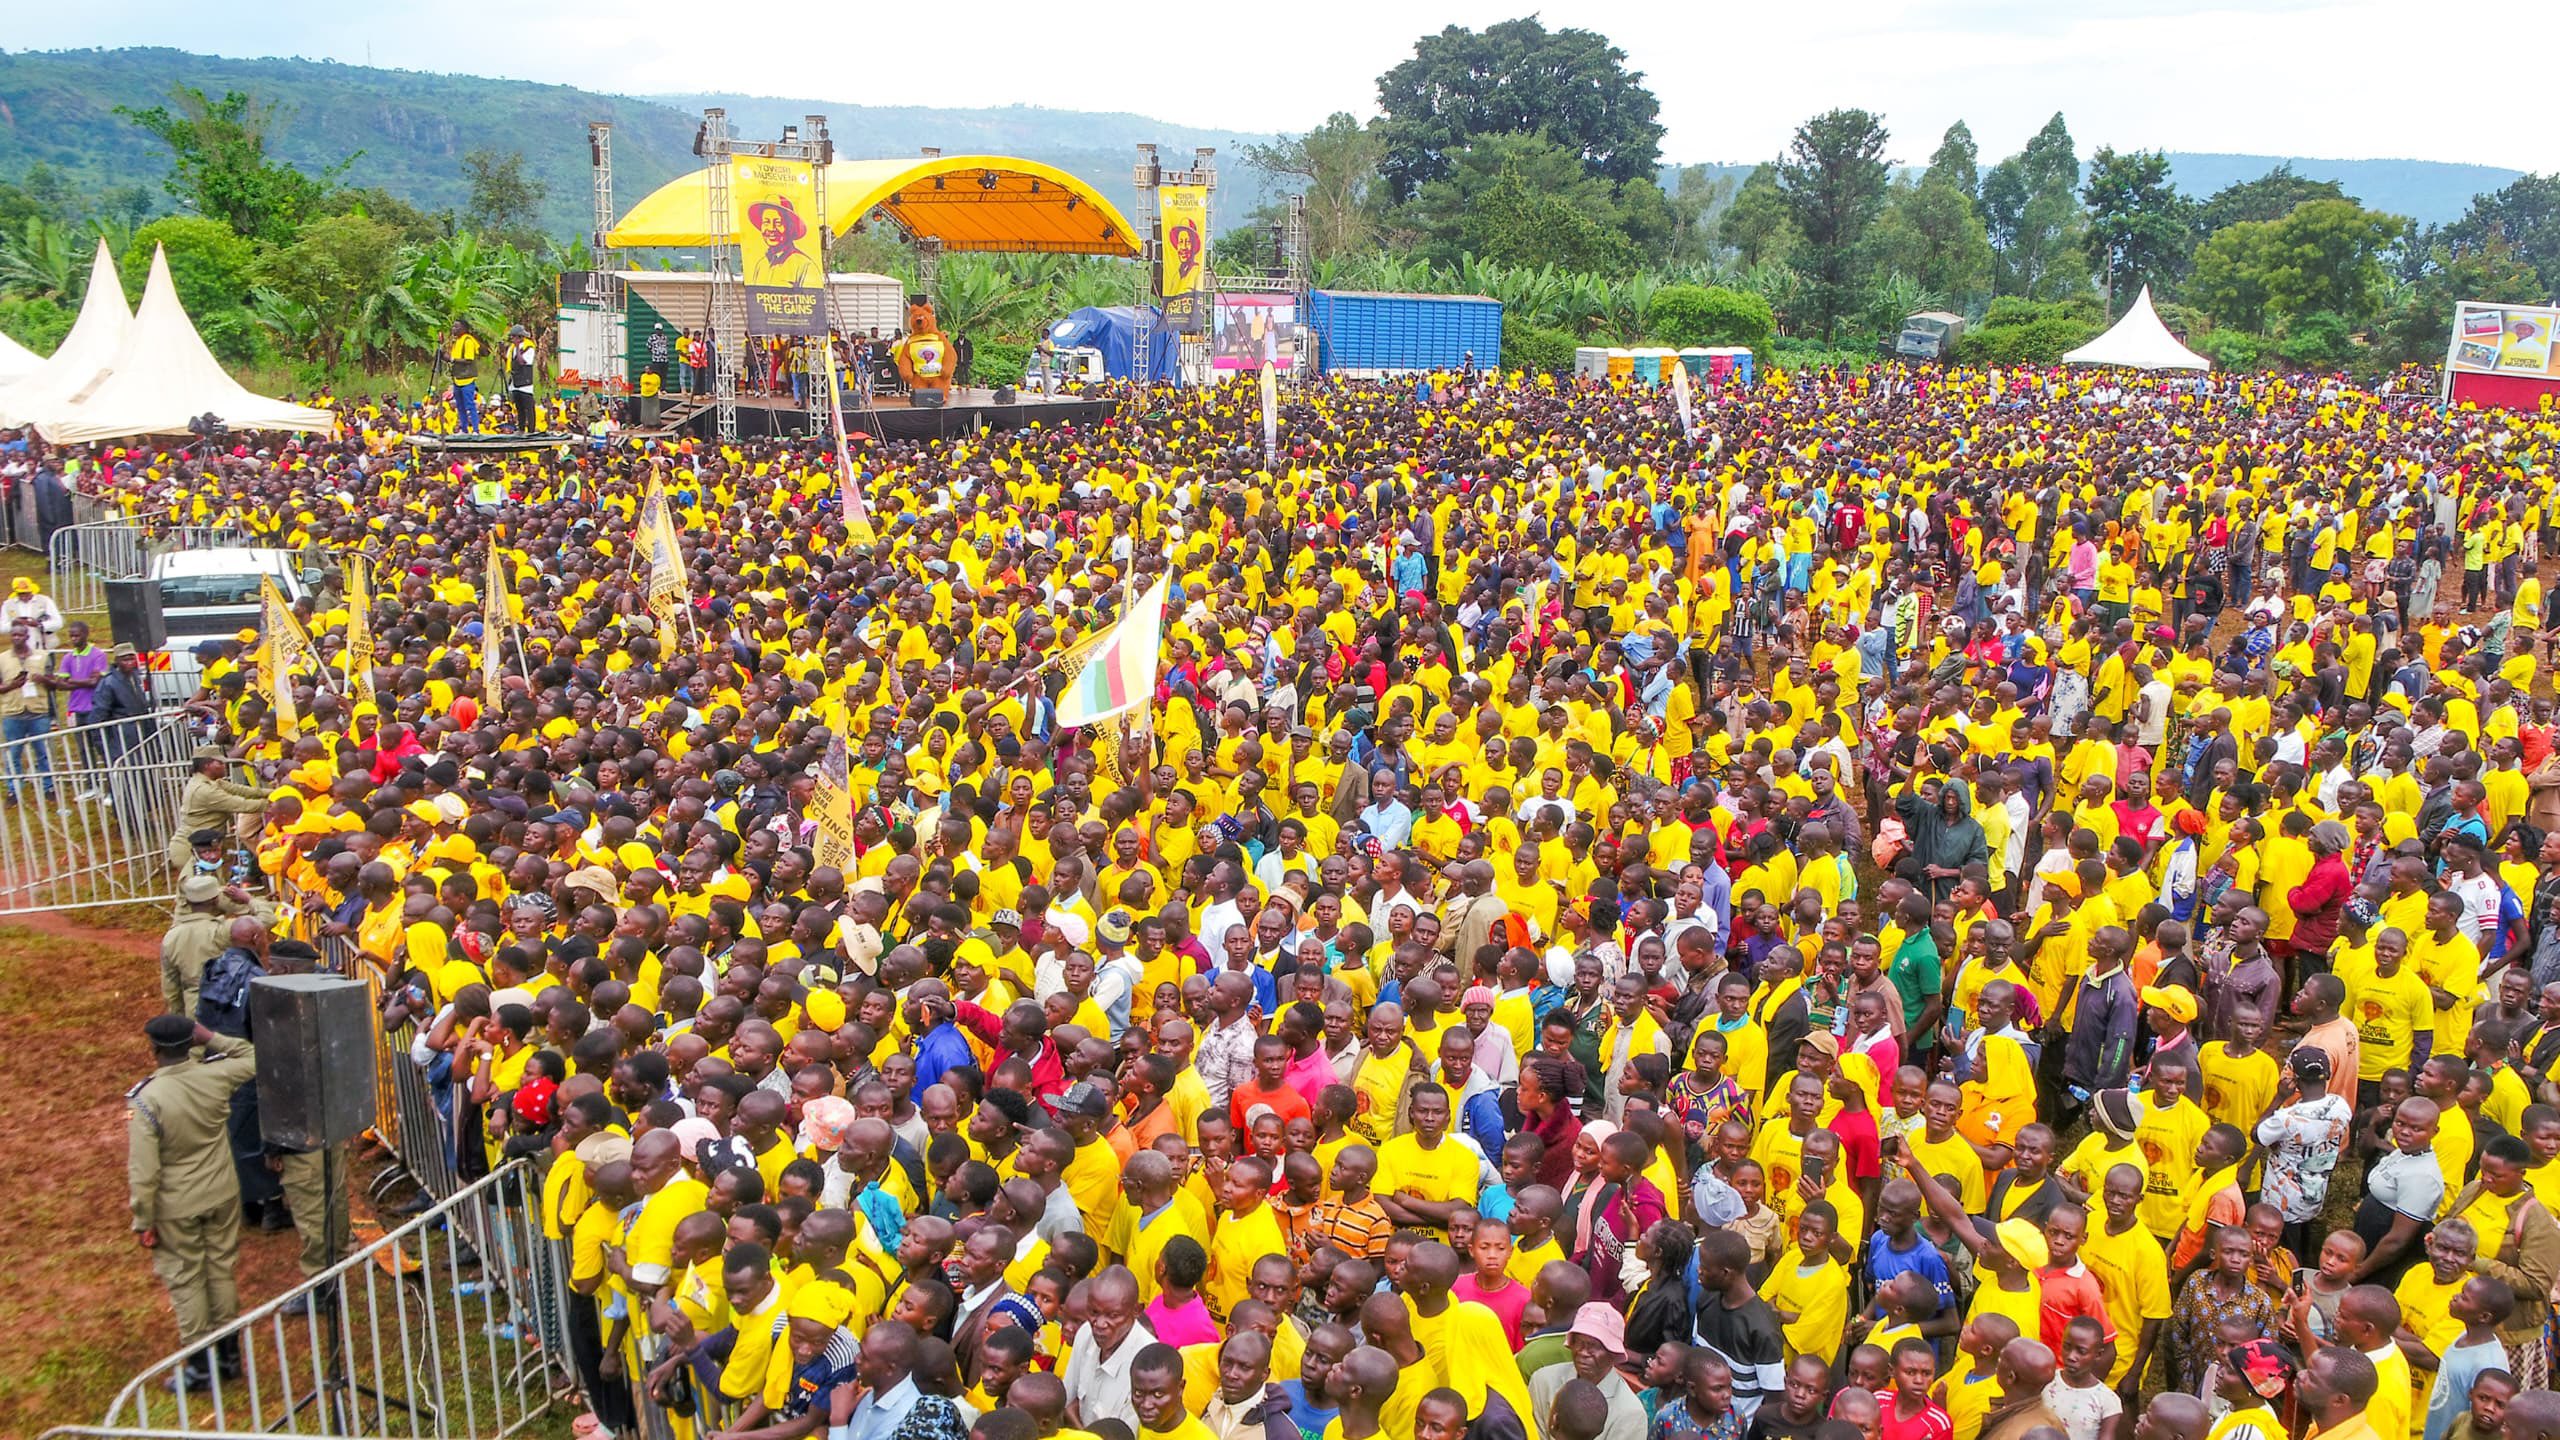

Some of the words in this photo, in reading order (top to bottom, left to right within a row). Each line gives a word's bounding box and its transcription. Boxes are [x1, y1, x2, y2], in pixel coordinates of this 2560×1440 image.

[758, 163, 791, 173] YOWERI
[754, 170, 797, 182] MUSEVENI
[756, 292, 817, 305] PROTECTING
[762, 303, 783, 314] THE
[784, 304, 813, 315] GAINS
[1845, 513, 1853, 529] 6
